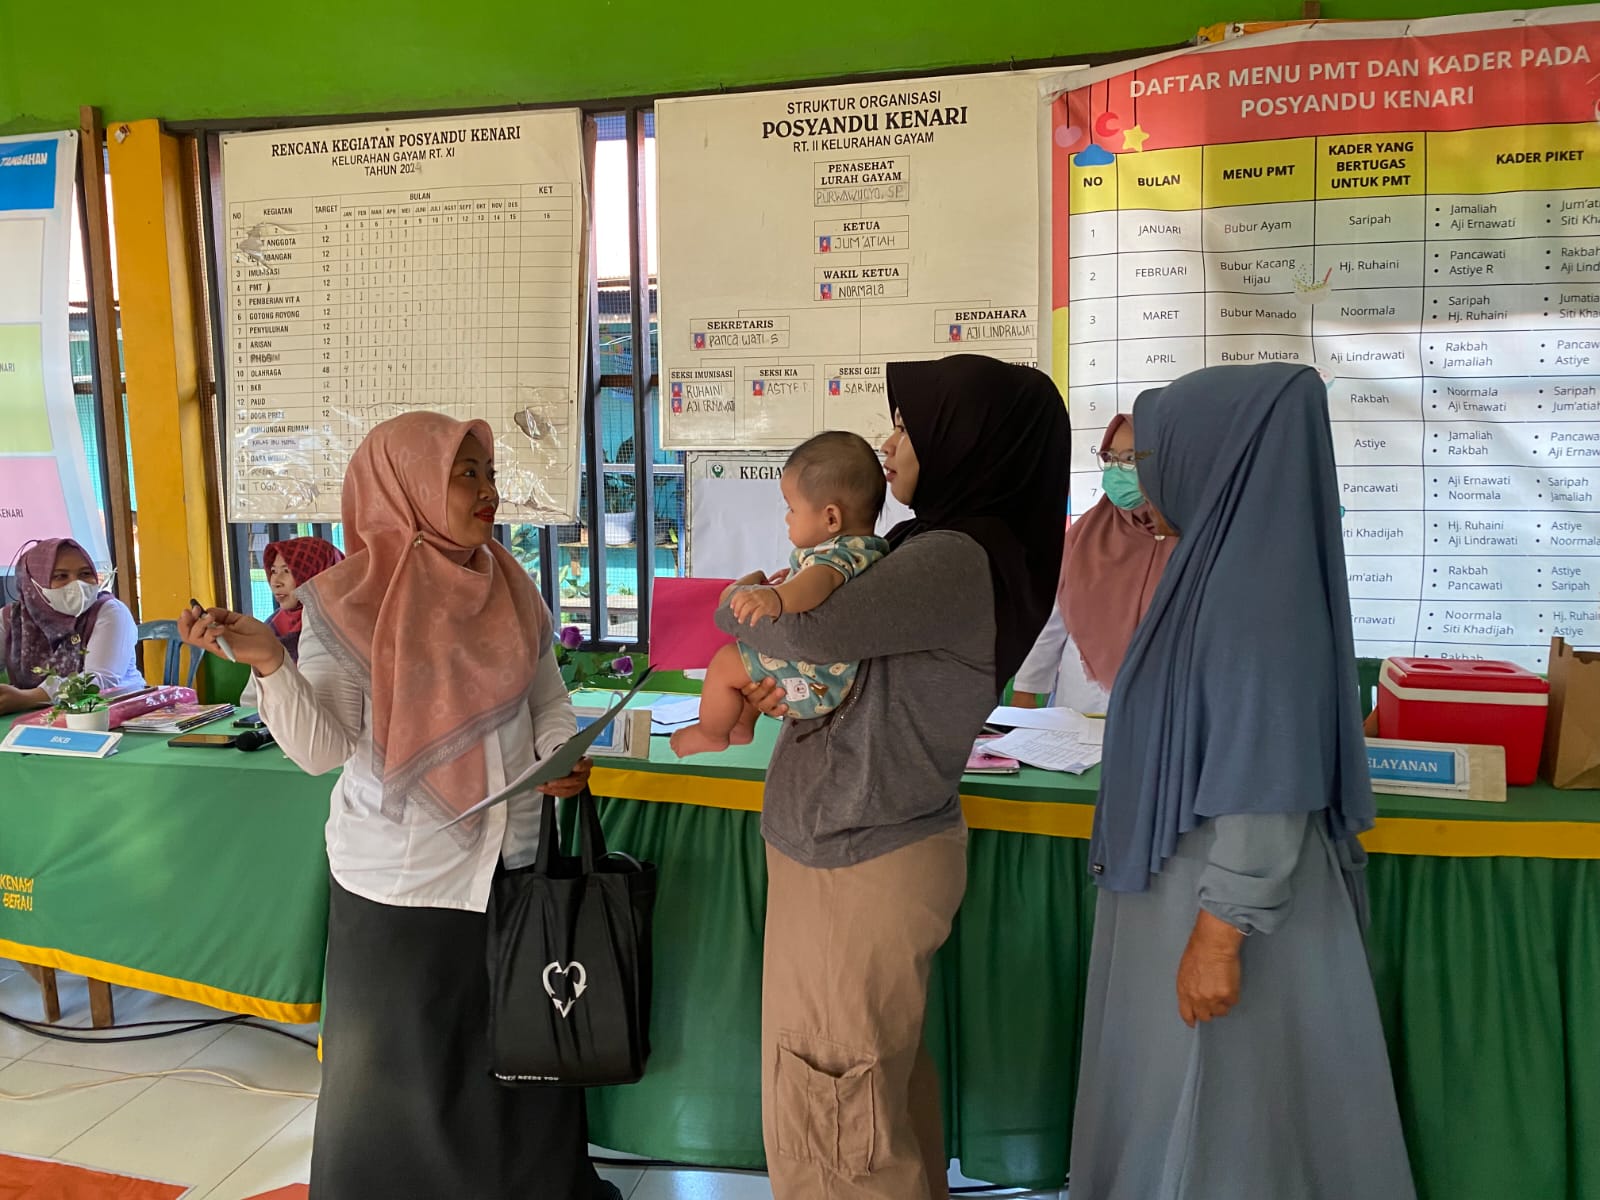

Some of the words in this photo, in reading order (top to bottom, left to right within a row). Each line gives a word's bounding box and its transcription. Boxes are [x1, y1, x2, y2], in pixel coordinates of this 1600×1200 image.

[1130, 72, 1220, 97] DAFTAR
[1229, 64, 1300, 87] MENU
[1309, 62, 1360, 80] PMT
[1368, 59, 1418, 78] DAN
[1428, 51, 1512, 76] KADER
[1521, 45, 1591, 67] PADA
[788, 98, 855, 114] STRUKTUR
[860, 91, 941, 109] ORGANISASI
[1241, 92, 1376, 118] POSYANDU
[1384, 86, 1474, 109] KENARI
[762, 114, 878, 138] POSYANDU
[886, 106, 968, 129] KENARI
[272, 141, 328, 157] RENCANA
[333, 136, 394, 152] KEGIATAN
[400, 130, 466, 147] POSYANDU
[471, 126, 520, 142] KENARI
[793, 142, 809, 152] RT.
[812, 141, 818, 151] II
[822, 135, 891, 150] KELURAHAN
[894, 132, 934, 146] GAYAM
[1329, 144, 1372, 156] KADER
[1376, 141, 1414, 152] YANG
[332, 153, 389, 166] KELURAHAN
[393, 150, 426, 161] GAYAM
[430, 148, 442, 159] RT.
[446, 147, 454, 157] XI
[1496, 152, 1542, 165] KADER
[1545, 150, 1584, 162] PIKET
[828, 161, 894, 173] PENASEHAT
[1337, 158, 1406, 171] BERTUGAS
[365, 165, 396, 176] TAHUN
[1223, 168, 1262, 180] MENU
[1267, 165, 1295, 177] PMT
[821, 174, 858, 186] LURAH
[862, 172, 901, 183] GAYAM
[1084, 176, 1103, 187] NO
[1138, 174, 1181, 187] BULAN
[1331, 176, 1378, 188] UNTUK
[1382, 174, 1411, 186] PMT
[315, 205, 337, 213] TARGET
[1450, 204, 1496, 215] Jamaliah
[1349, 214, 1391, 227] Saripah
[1451, 219, 1464, 230] Aji
[1468, 218, 1515, 229] Ernawati
[1561, 216, 1578, 225] Siti
[843, 222, 880, 231] KETUA
[1138, 225, 1181, 236] JANUARI
[1224, 224, 1256, 234] Bubur
[1260, 220, 1292, 233] Ayam
[835, 236, 895, 250] JUM'ATIAH
[1450, 250, 1506, 260] Pancawati
[1220, 262, 1252, 271] Bubur
[1256, 258, 1295, 270] Kacang
[1340, 261, 1354, 273] Hj.
[1358, 260, 1399, 270] Ruhaini
[1560, 262, 1573, 274] Aji
[823, 269, 858, 279] WAKIL
[862, 268, 899, 278] KETUA
[1136, 266, 1187, 277] FEBRUARI
[1450, 265, 1483, 276] Astiye
[1243, 275, 1271, 286] Hijau
[1449, 296, 1490, 307] Saripah
[956, 310, 1027, 320] BENDAHARA
[1143, 311, 1179, 320] MARET
[1221, 309, 1252, 318] Bubur
[1255, 309, 1297, 319] Manado
[1341, 306, 1396, 316] Noormala
[1448, 312, 1462, 322] Hj.
[1466, 310, 1508, 320] Ruhaini
[1560, 309, 1576, 318] Siti
[708, 320, 774, 330] SEKRETARIS
[967, 326, 980, 340] AJI
[1446, 342, 1488, 351] Rakbah
[1146, 354, 1176, 363] APRIL
[1221, 351, 1254, 361] Bubur
[1258, 351, 1299, 360] Mutiara
[1330, 352, 1344, 363] Aji
[1346, 351, 1405, 362] Lindrawati
[1555, 356, 1590, 367] Astiye
[1443, 357, 1493, 368] Jamaliah
[251, 369, 281, 377] OLAHRAGA
[839, 368, 861, 376] SEKSI
[1448, 387, 1498, 397] Noormala
[1554, 386, 1596, 398] Saripah
[1351, 394, 1389, 404] Rakbah
[1448, 401, 1461, 412] Aji
[1463, 401, 1506, 412] Ernawati
[1448, 431, 1493, 441] Jamaliah
[1354, 439, 1386, 448] Astiye
[1449, 446, 1488, 455] Rakbah
[1548, 447, 1562, 459] Aji
[740, 466, 782, 479] KEGIA
[1448, 476, 1461, 487] Aji
[1464, 476, 1511, 485] Ernawati
[1548, 478, 1588, 488] Saripah
[1344, 483, 1398, 493] Pancawati
[1449, 491, 1501, 500] Noormala
[1551, 492, 1592, 502] Jamaliah
[1448, 521, 1462, 532] Hj.
[1465, 520, 1504, 530] Ruhaini
[1551, 521, 1582, 533] Astiye
[1356, 528, 1403, 540] Khadijah
[1448, 536, 1461, 547] Aji
[1465, 536, 1518, 545] Lindrawati
[1551, 537, 1600, 546] Noormala
[1449, 566, 1488, 575] Rakbah
[1552, 566, 1581, 578] Astiye
[1448, 581, 1502, 590] Pancawati
[1552, 581, 1590, 592] Saripah
[1446, 611, 1502, 620] Noormala
[1553, 612, 1567, 622] Hj.
[1443, 625, 1461, 634] Siti
[1464, 625, 1514, 636] Khadijah
[1553, 627, 1584, 636] Astiye
[1368, 758, 1438, 772] ELAYANAN
